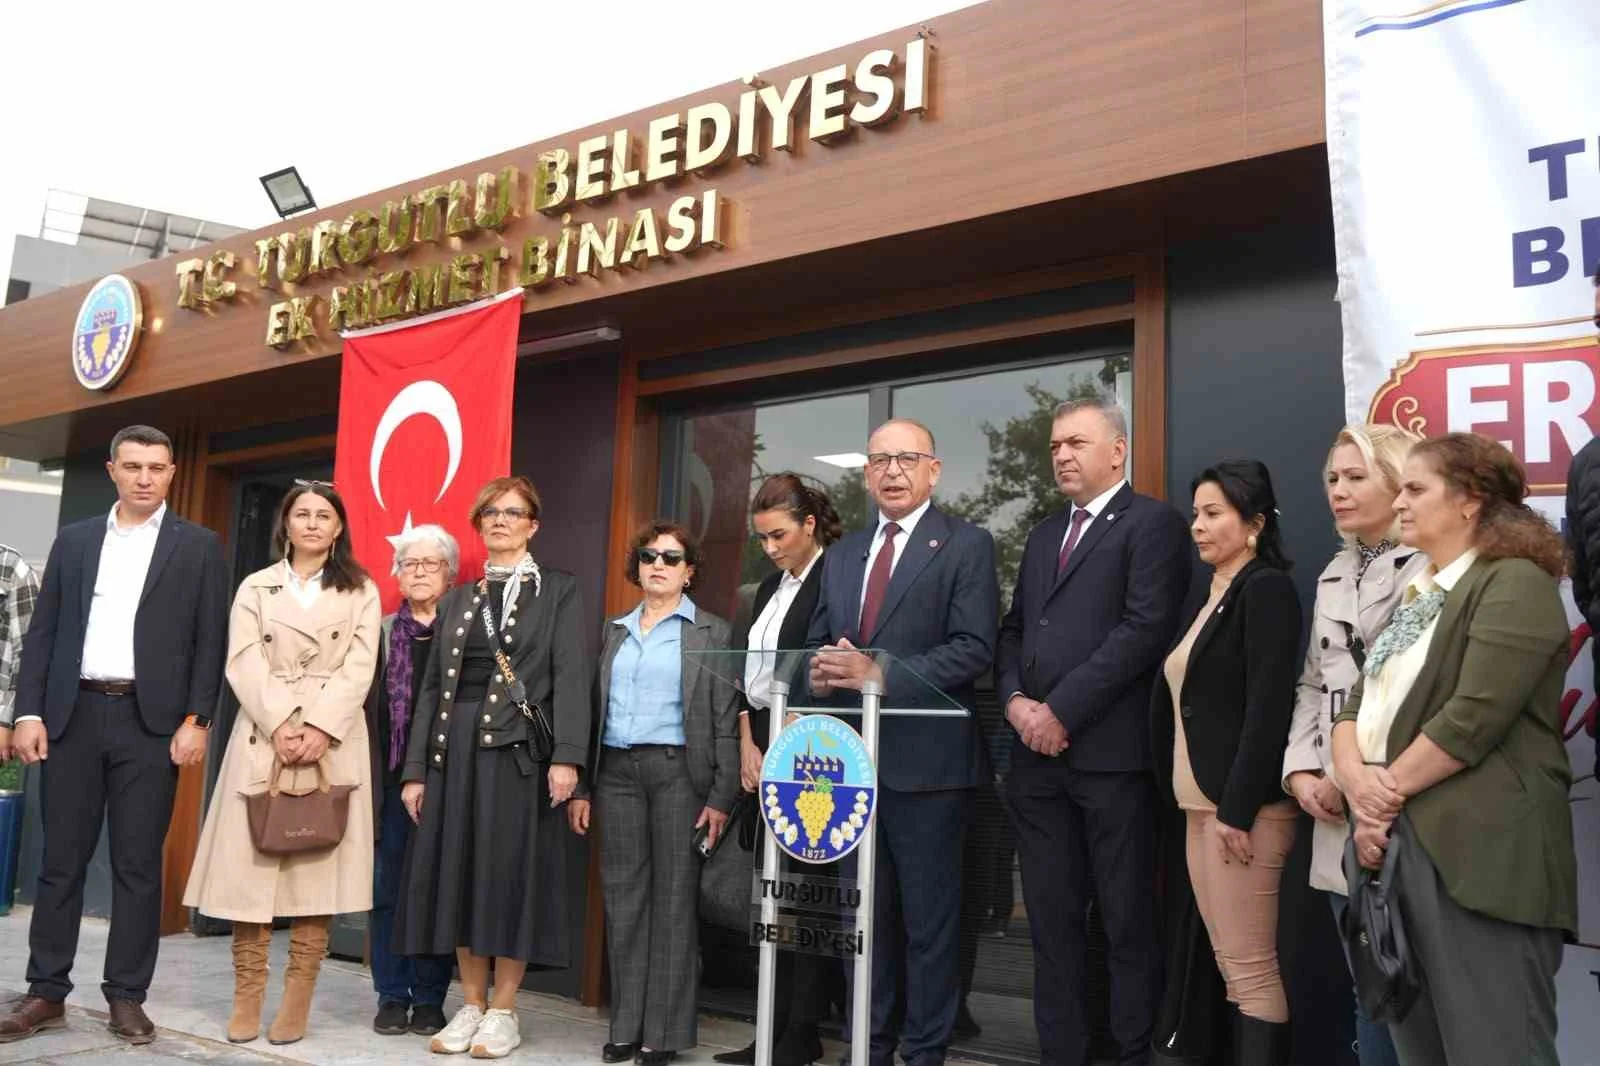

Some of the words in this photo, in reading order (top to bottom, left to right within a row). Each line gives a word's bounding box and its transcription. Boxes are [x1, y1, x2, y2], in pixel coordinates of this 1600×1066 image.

[256, 165, 519, 288] TURGUTLU
[266, 296, 317, 346] EK
[519, 188, 720, 286] BİNASI
